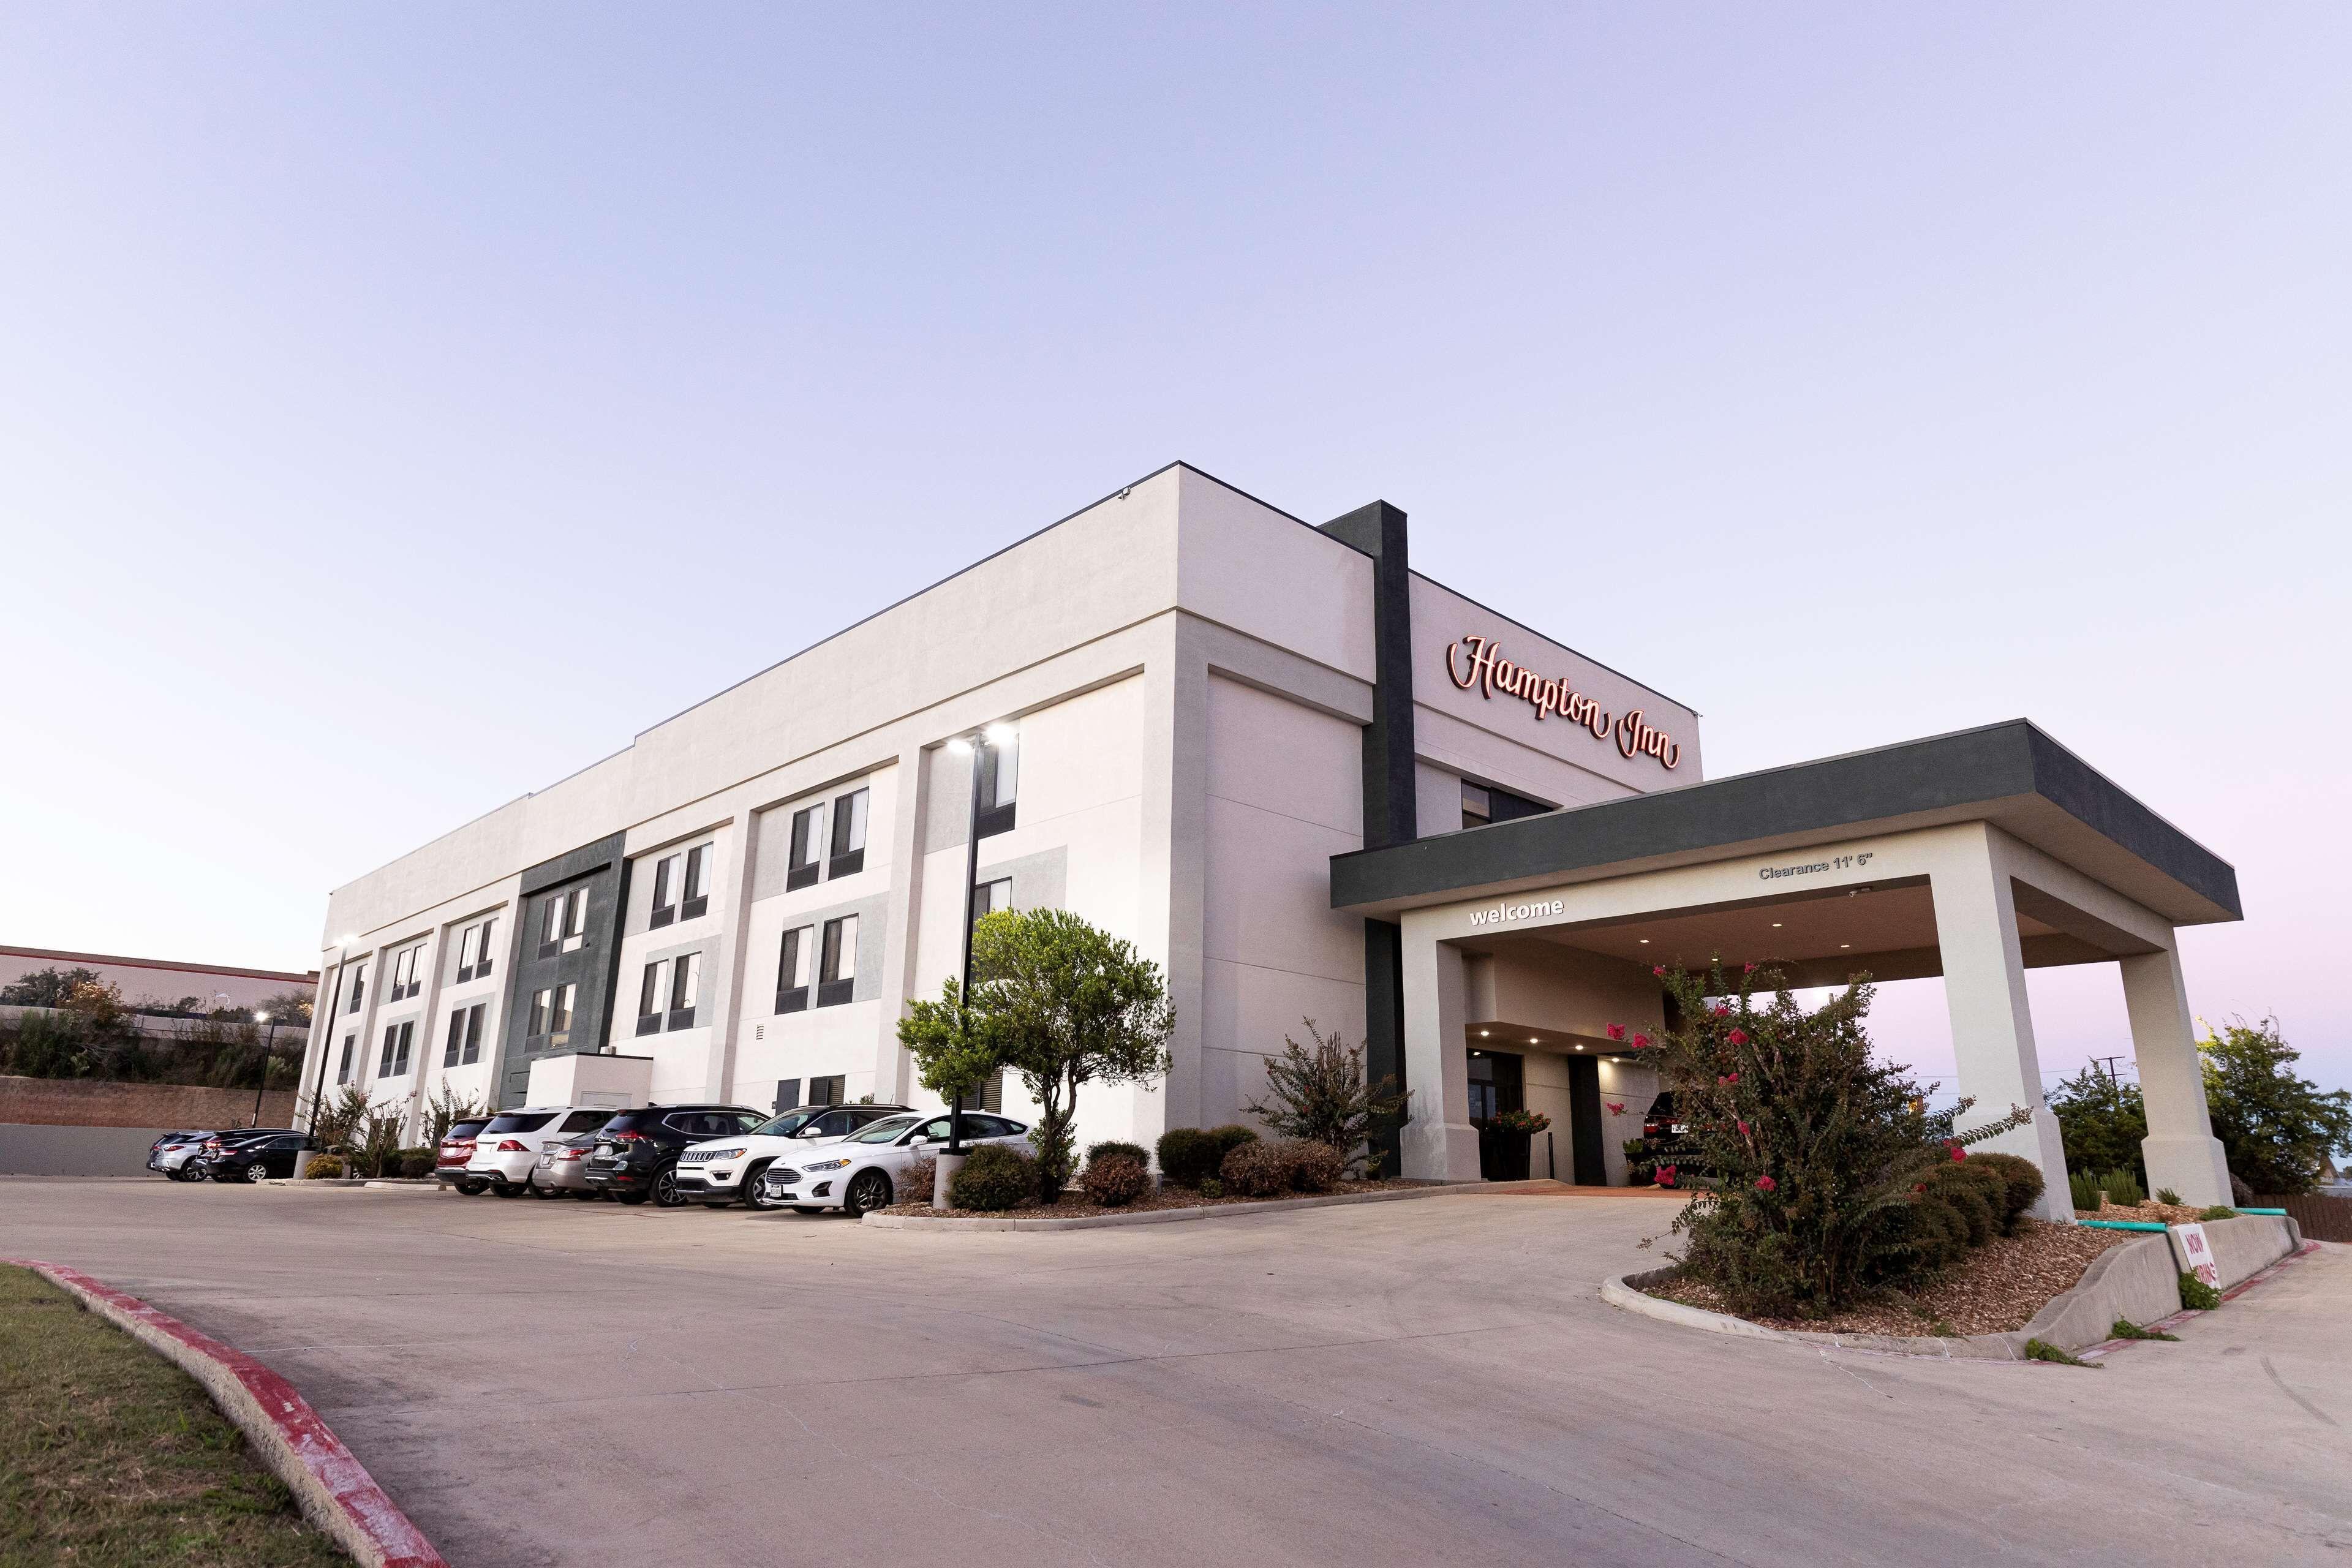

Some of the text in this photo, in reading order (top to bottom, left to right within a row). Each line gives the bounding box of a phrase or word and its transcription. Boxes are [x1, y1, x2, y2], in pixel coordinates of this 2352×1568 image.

[1446, 636, 1680, 770] Hampton Inn
[1759, 860, 1829, 880] Clearance
[1469, 900, 1564, 926] welcome
[2185, 1233, 2204, 1254] NOW
